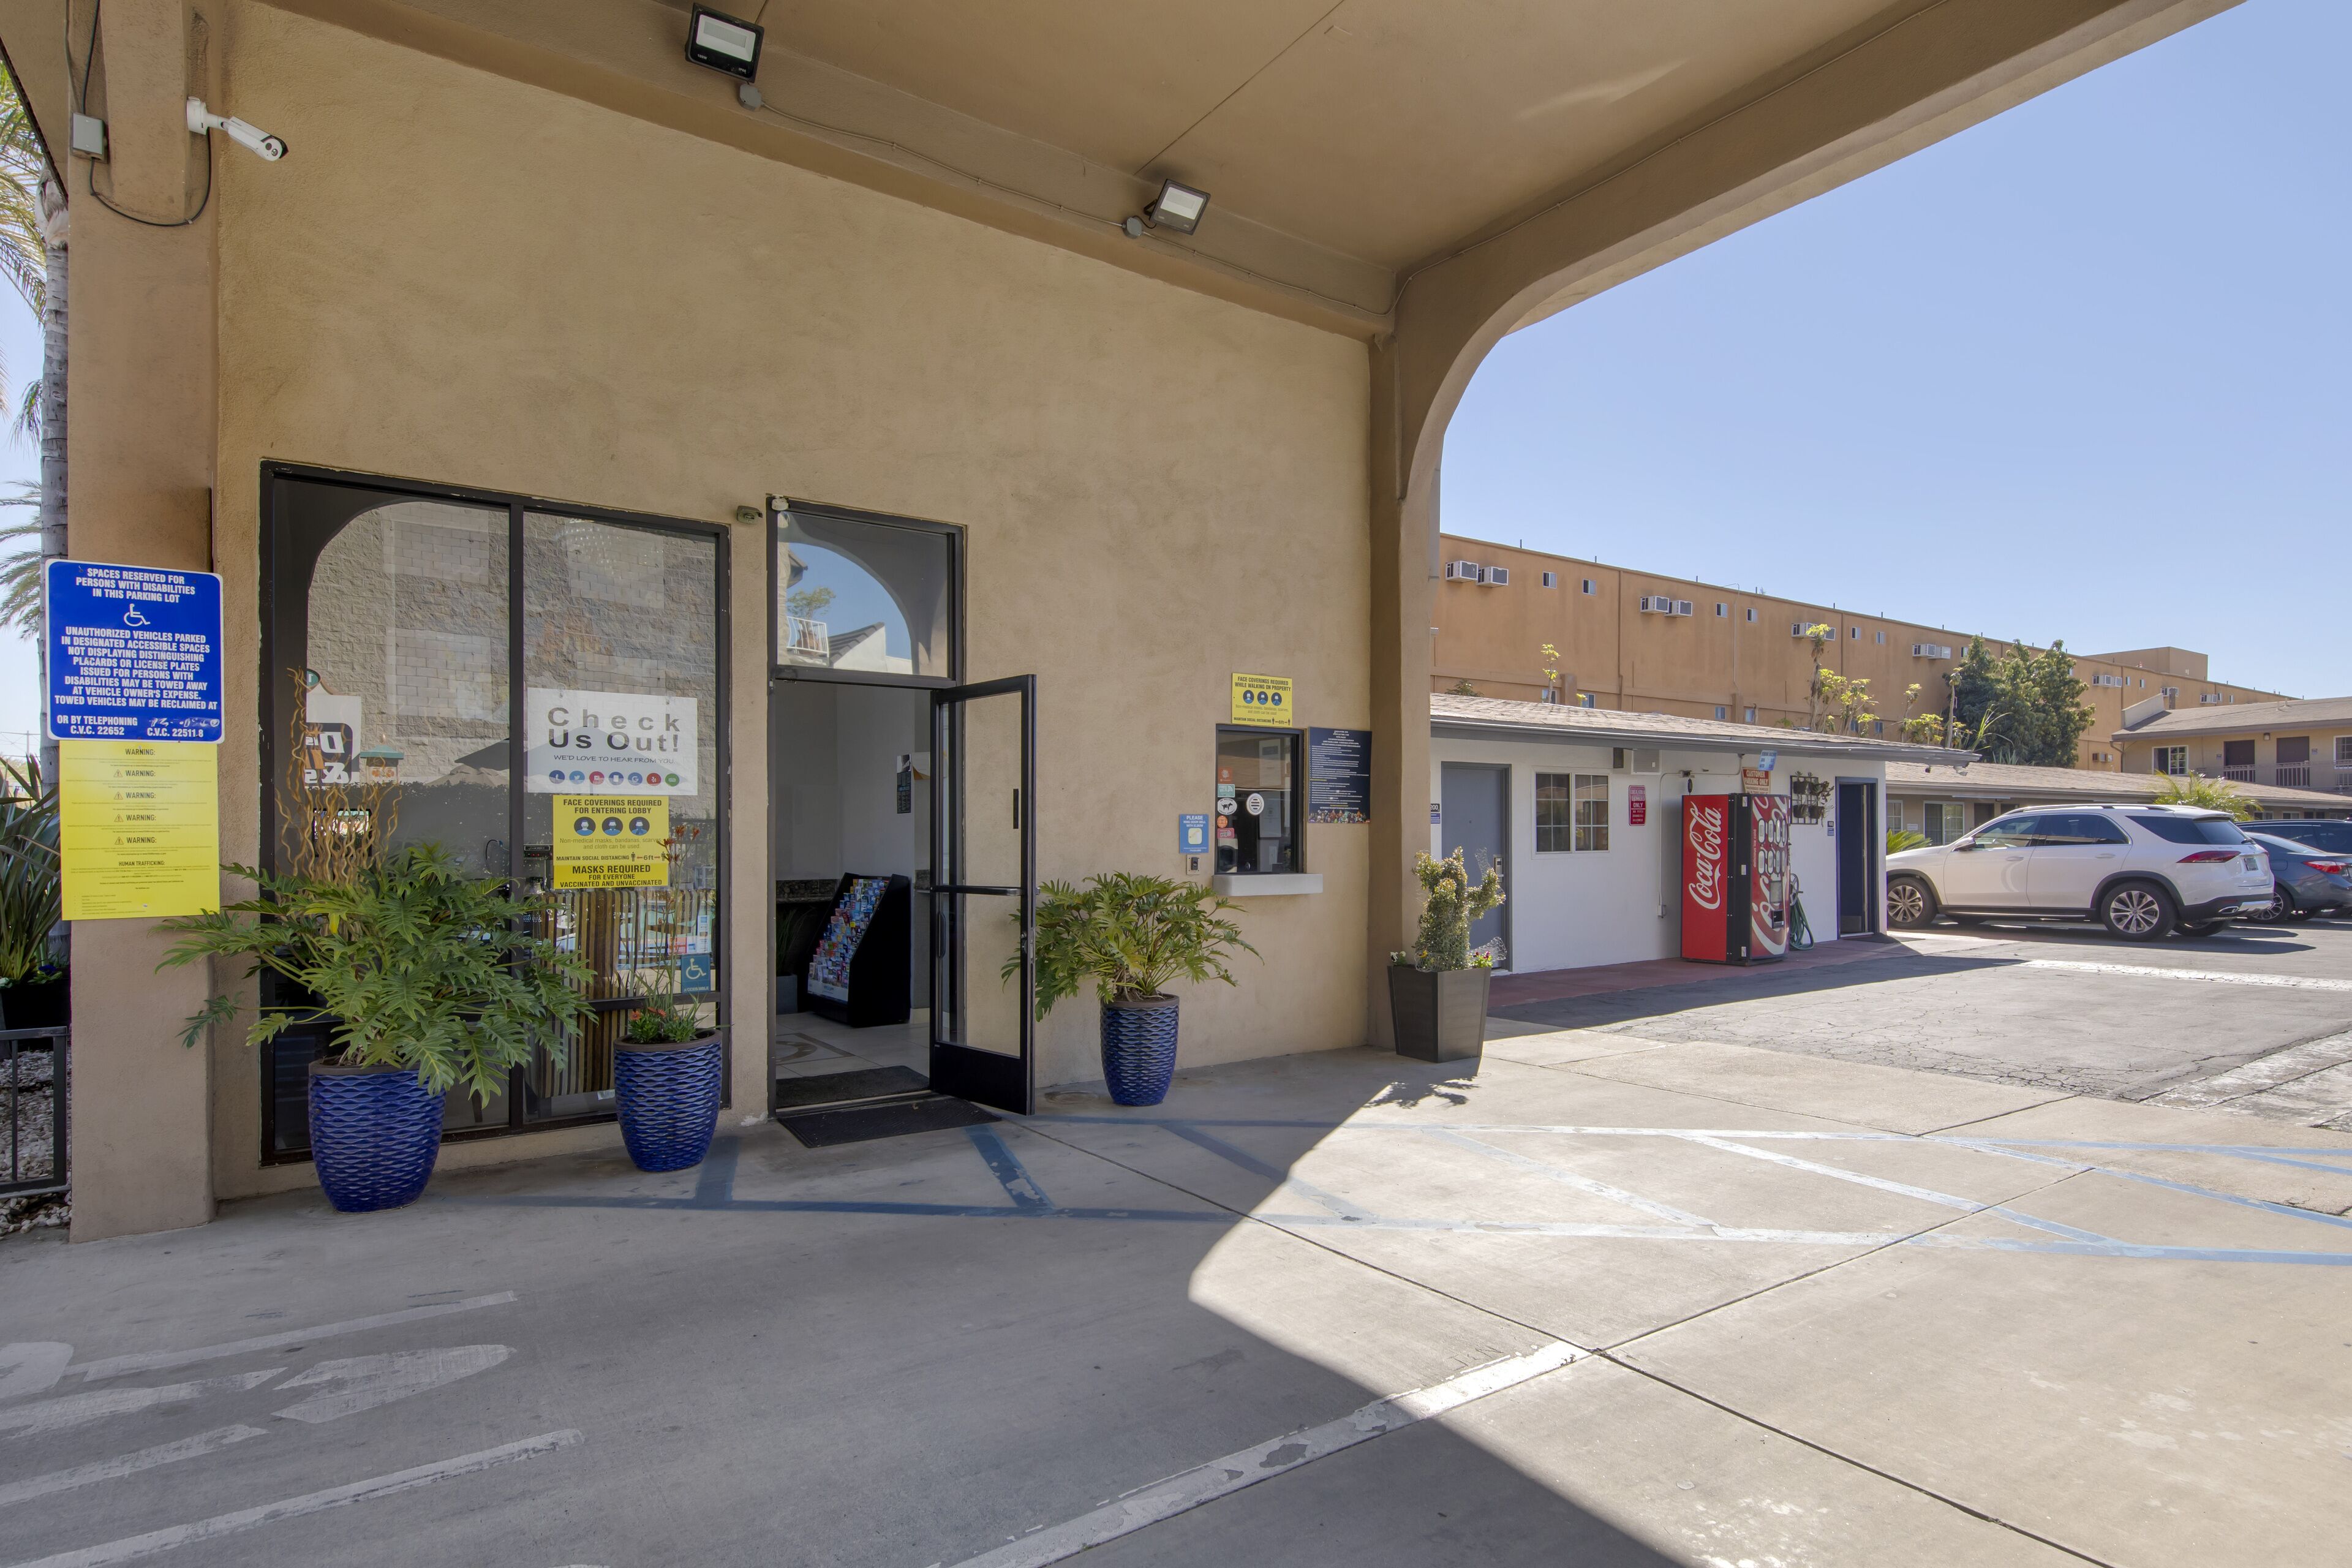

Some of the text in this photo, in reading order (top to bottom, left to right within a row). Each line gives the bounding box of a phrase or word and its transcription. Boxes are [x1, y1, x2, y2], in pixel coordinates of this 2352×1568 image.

[87, 568, 184, 584] SPACES RESERVED FOR
[76, 577, 195, 595] PERSONS WITH DISABILITIES
[92, 589, 102, 597] IN
[104, 589, 124, 598] THIS
[126, 591, 162, 601] PARKING
[66, 627, 206, 643] UNAUTHORIZED VEHICLES PARKED
[73, 636, 125, 648] DESIGNATED
[127, 640, 177, 651] ACCESSIBLE
[179, 644, 210, 654] SPACES
[68, 646, 204, 662] NOT DISPLAYING DISTINGUISHING
[73, 657, 200, 671] PLACARDS OR LICENSE PLATES
[80, 667, 194, 680] ISSUED FOR PERSONS WITH
[65, 676, 208, 690] DISABILITIES MAY BE TOWED AWAY
[72, 687, 201, 699] AT VEHICLE OWNER'S EXPENSE.
[55, 695, 218, 710] TOWED VEHICLES MAY BE RECLAIMED AT
[57, 715, 138, 726] OR BY TELEPHONING
[548, 707, 680, 732] Check
[70, 726, 124, 735] C.V.C. 22652
[147, 728, 203, 737] C.V.C. 22511.8
[549, 729, 678, 752] Us Out!
[572, 865, 605, 874] MASKS
